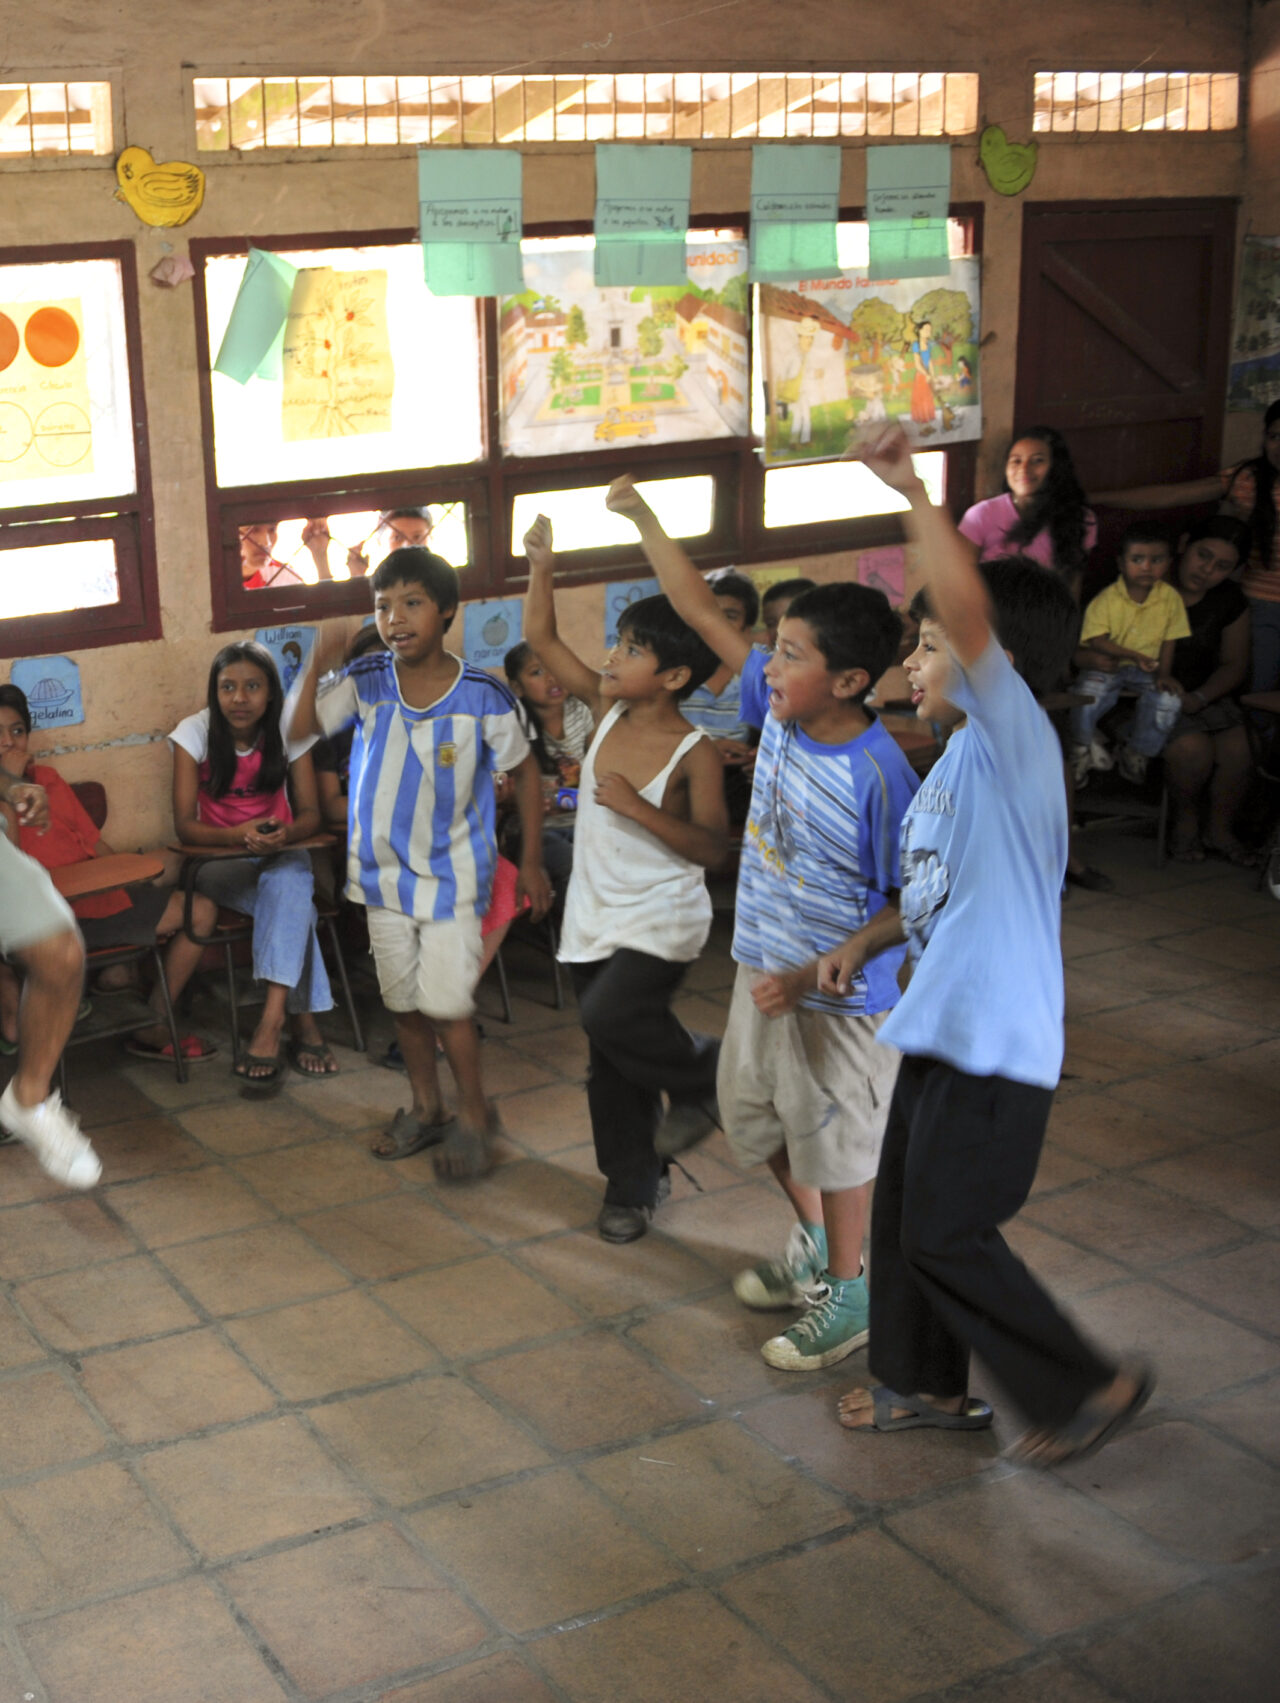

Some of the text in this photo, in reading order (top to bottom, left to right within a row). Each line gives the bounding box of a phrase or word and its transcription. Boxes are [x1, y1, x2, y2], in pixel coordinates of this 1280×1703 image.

[685, 250, 739, 267] unidad
[798, 279, 809, 292] El
[810, 277, 853, 291] Mundo
[264, 626, 303, 645] William
[29, 705, 74, 726] gelatina
